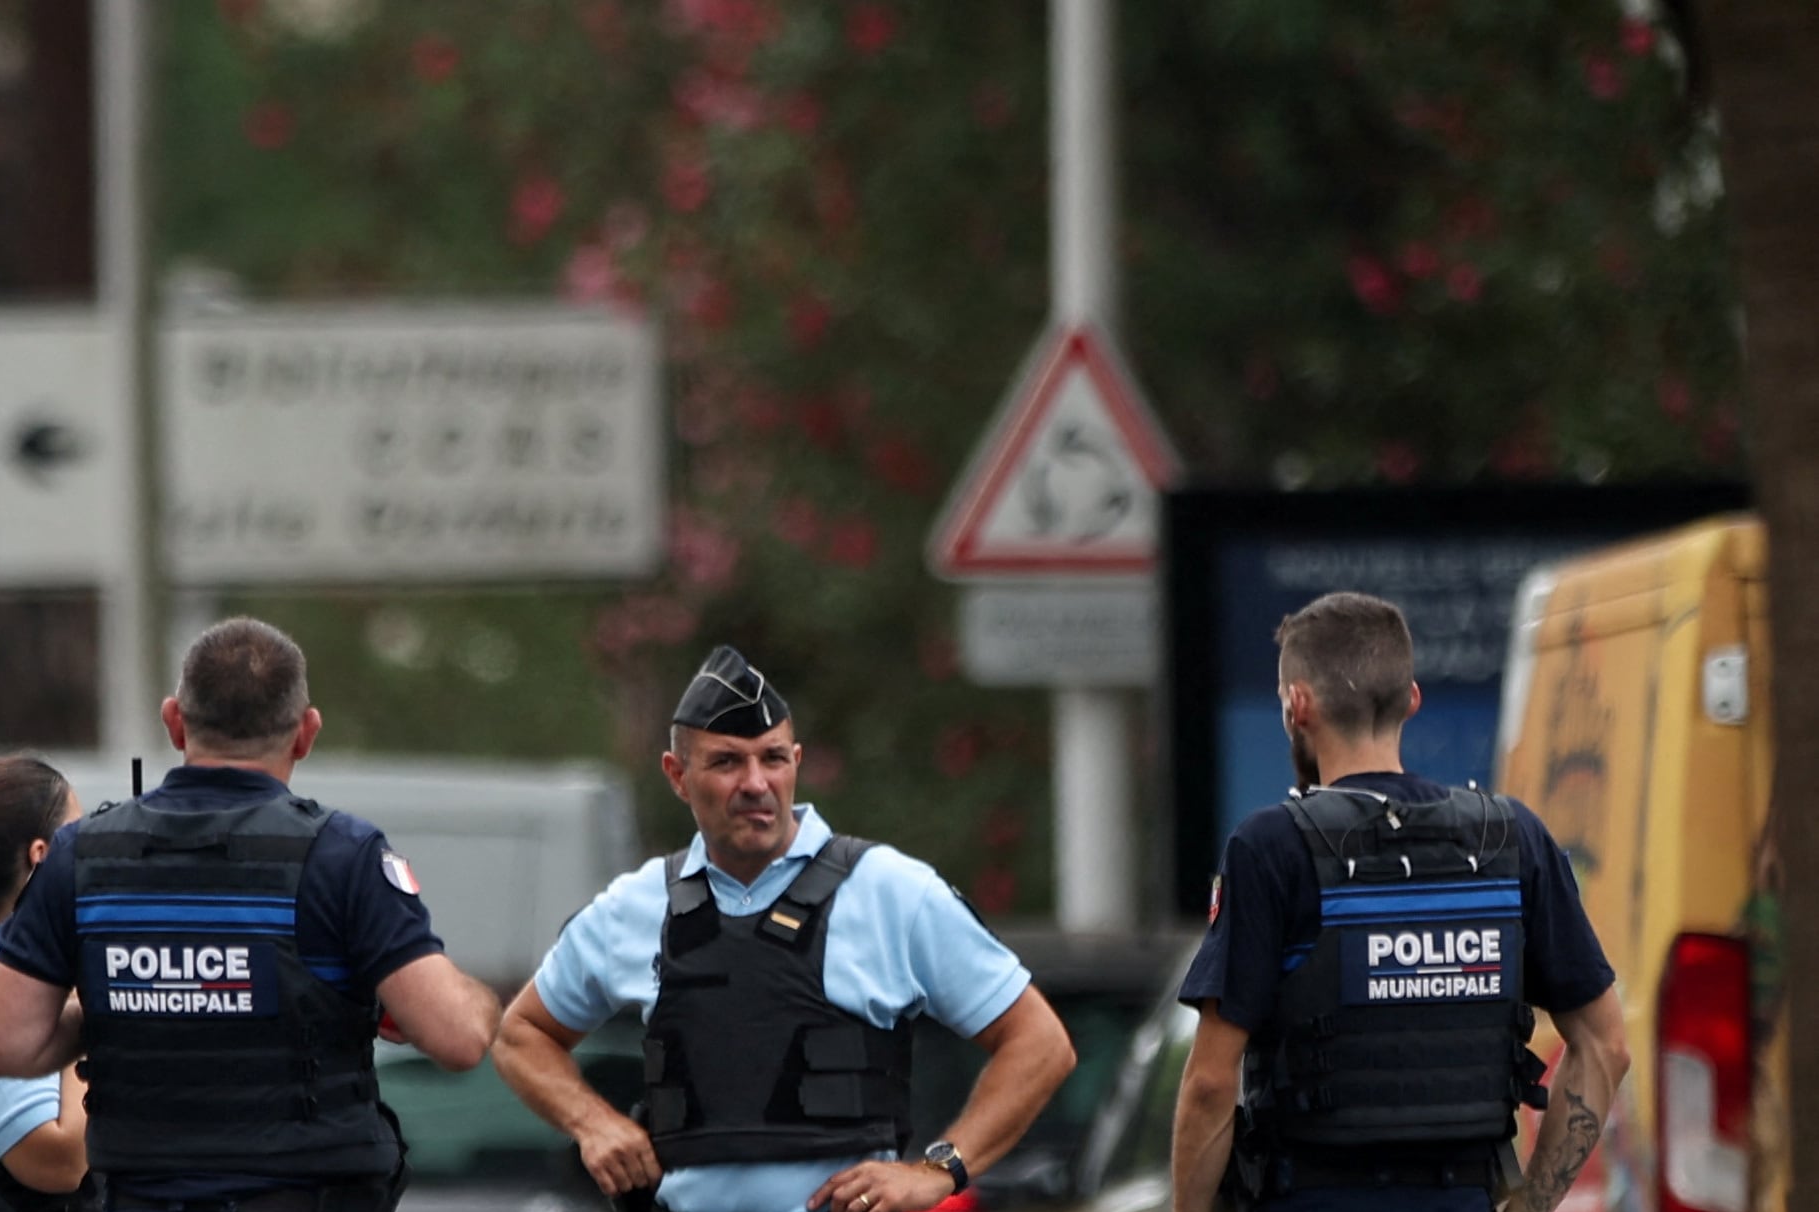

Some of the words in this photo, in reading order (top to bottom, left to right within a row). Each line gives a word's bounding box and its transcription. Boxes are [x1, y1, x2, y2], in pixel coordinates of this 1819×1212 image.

[1368, 929, 1501, 967] POLICE
[105, 946, 251, 981] POLICE
[108, 991, 253, 1014] MUNICIPALE
[1368, 975, 1501, 1000] MUNICIPALE
